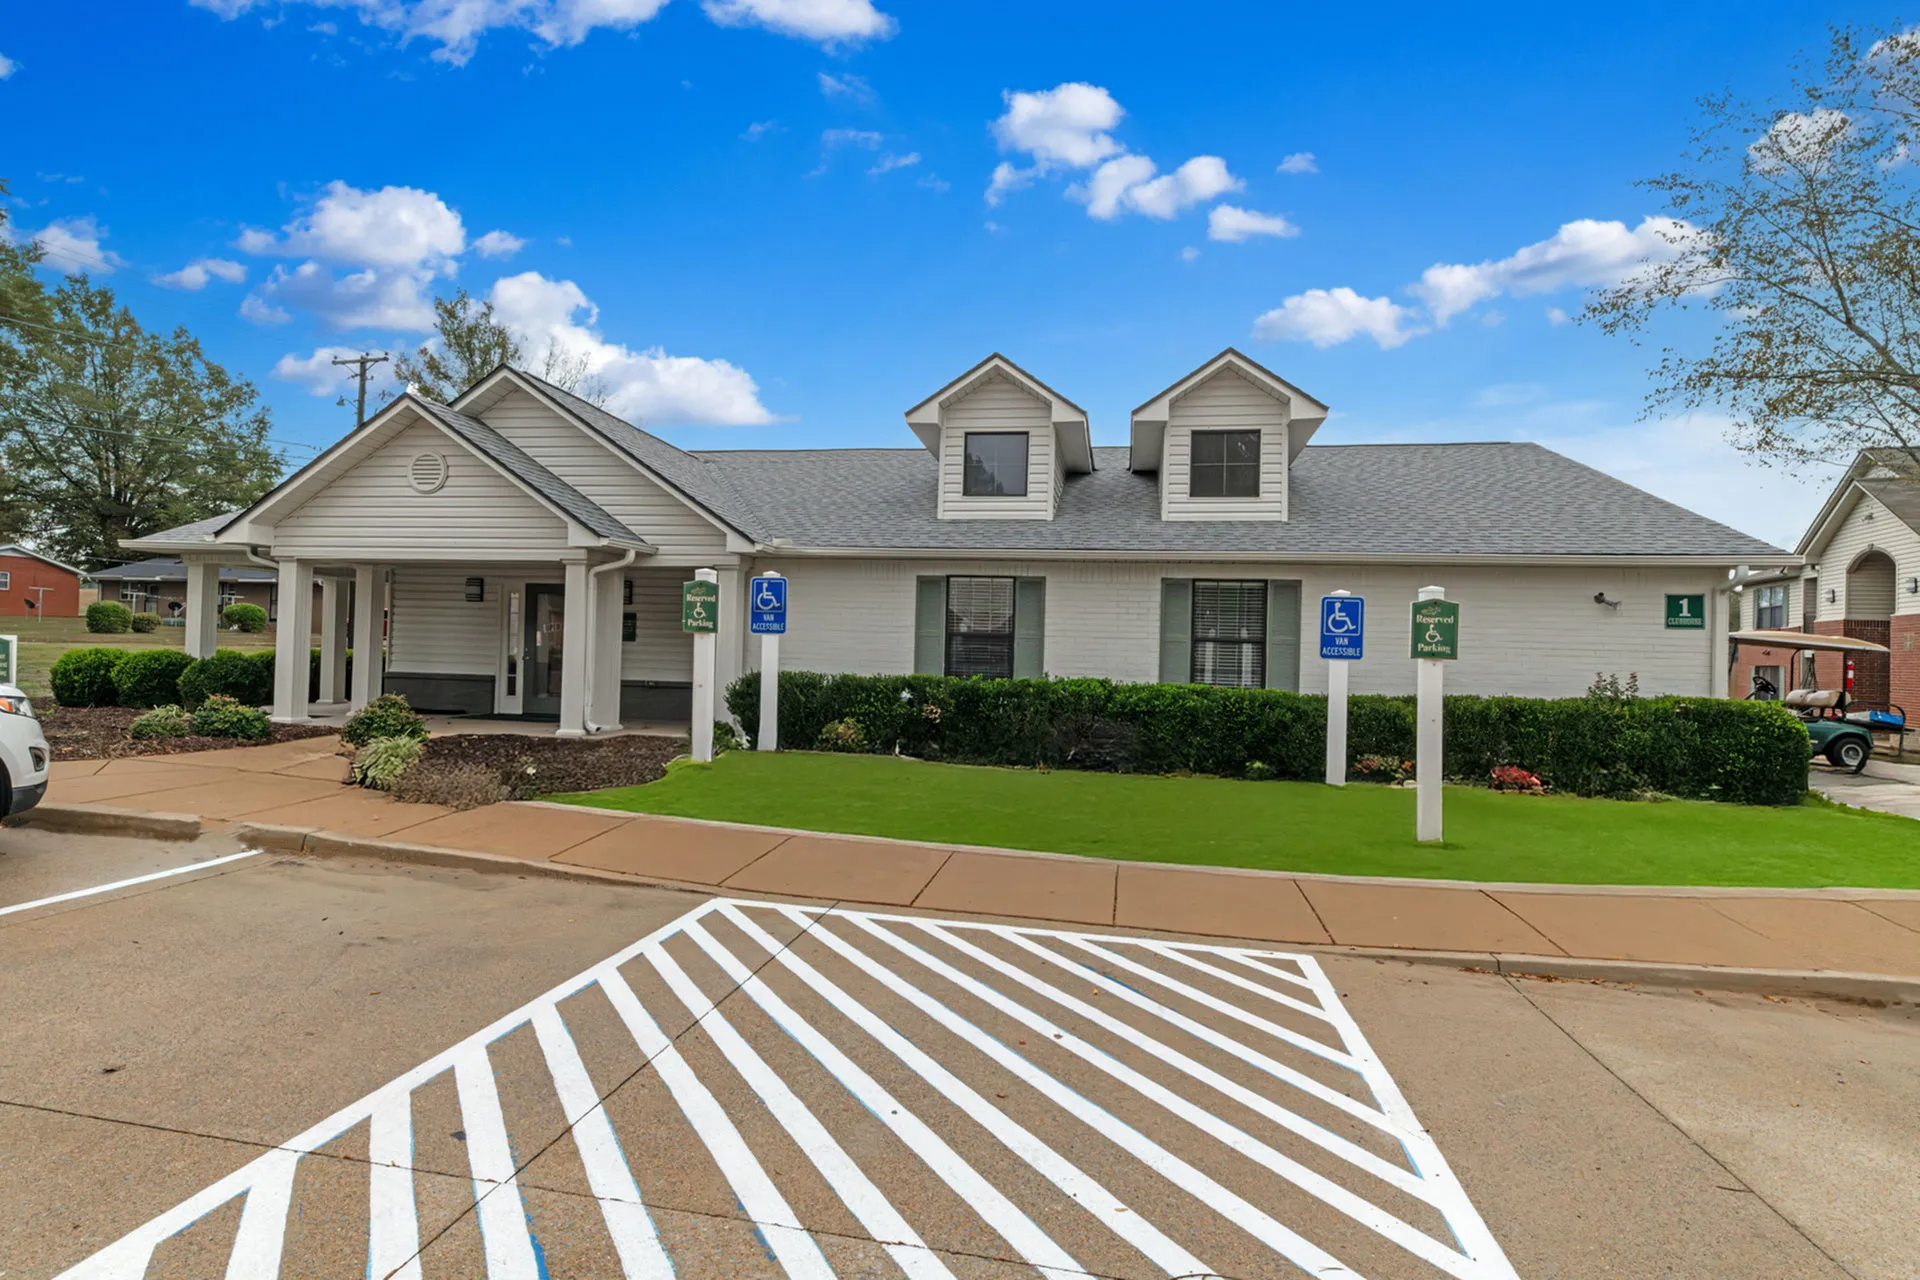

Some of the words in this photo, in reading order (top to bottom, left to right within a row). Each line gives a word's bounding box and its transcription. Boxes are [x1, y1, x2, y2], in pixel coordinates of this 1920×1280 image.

[686, 593, 716, 602] Reserved
[1679, 598, 1691, 616] 1
[763, 613, 775, 621] VAN
[1416, 614, 1454, 624] Reserved
[1335, 637, 1349, 645] VAN
[1321, 647, 1361, 656] ACCESSIBLE
[1417, 643, 1451, 654] Parking
